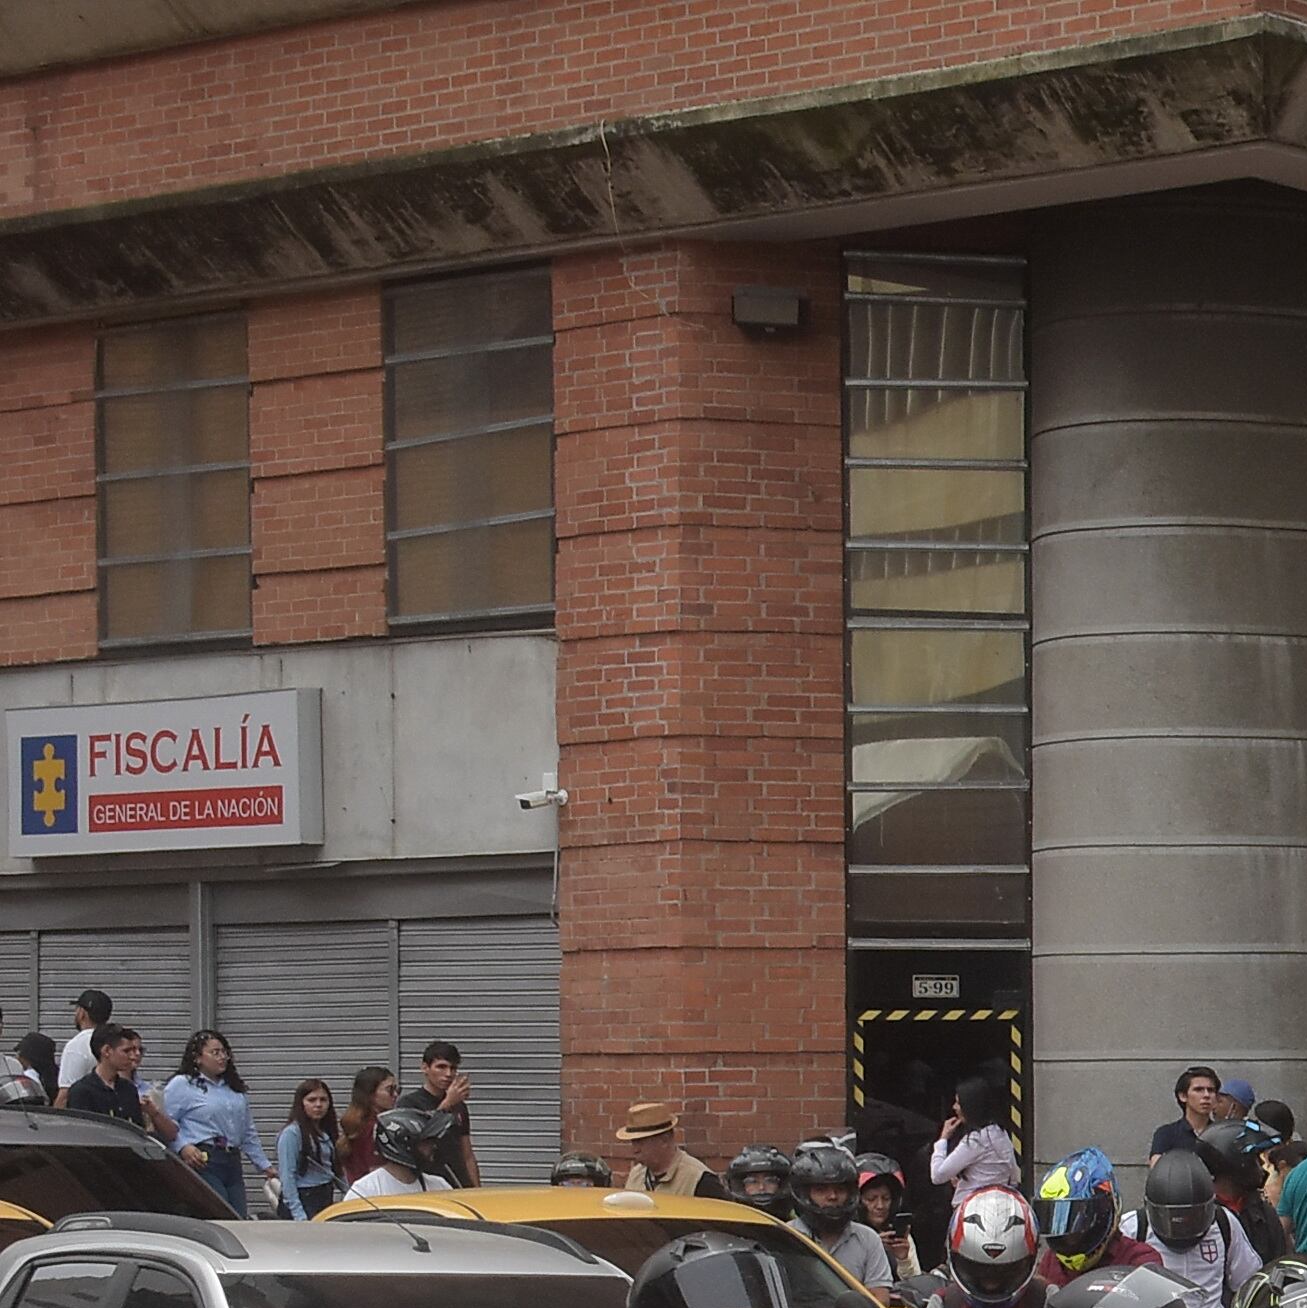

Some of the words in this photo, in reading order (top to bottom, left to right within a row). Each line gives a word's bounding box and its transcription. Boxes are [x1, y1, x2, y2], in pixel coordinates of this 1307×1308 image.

[88, 713, 282, 778] FISCALÍA
[93, 802, 166, 825] GENERAL
[169, 801, 191, 821] DE
[194, 799, 214, 820] LA
[217, 791, 278, 818] NACIÓN
